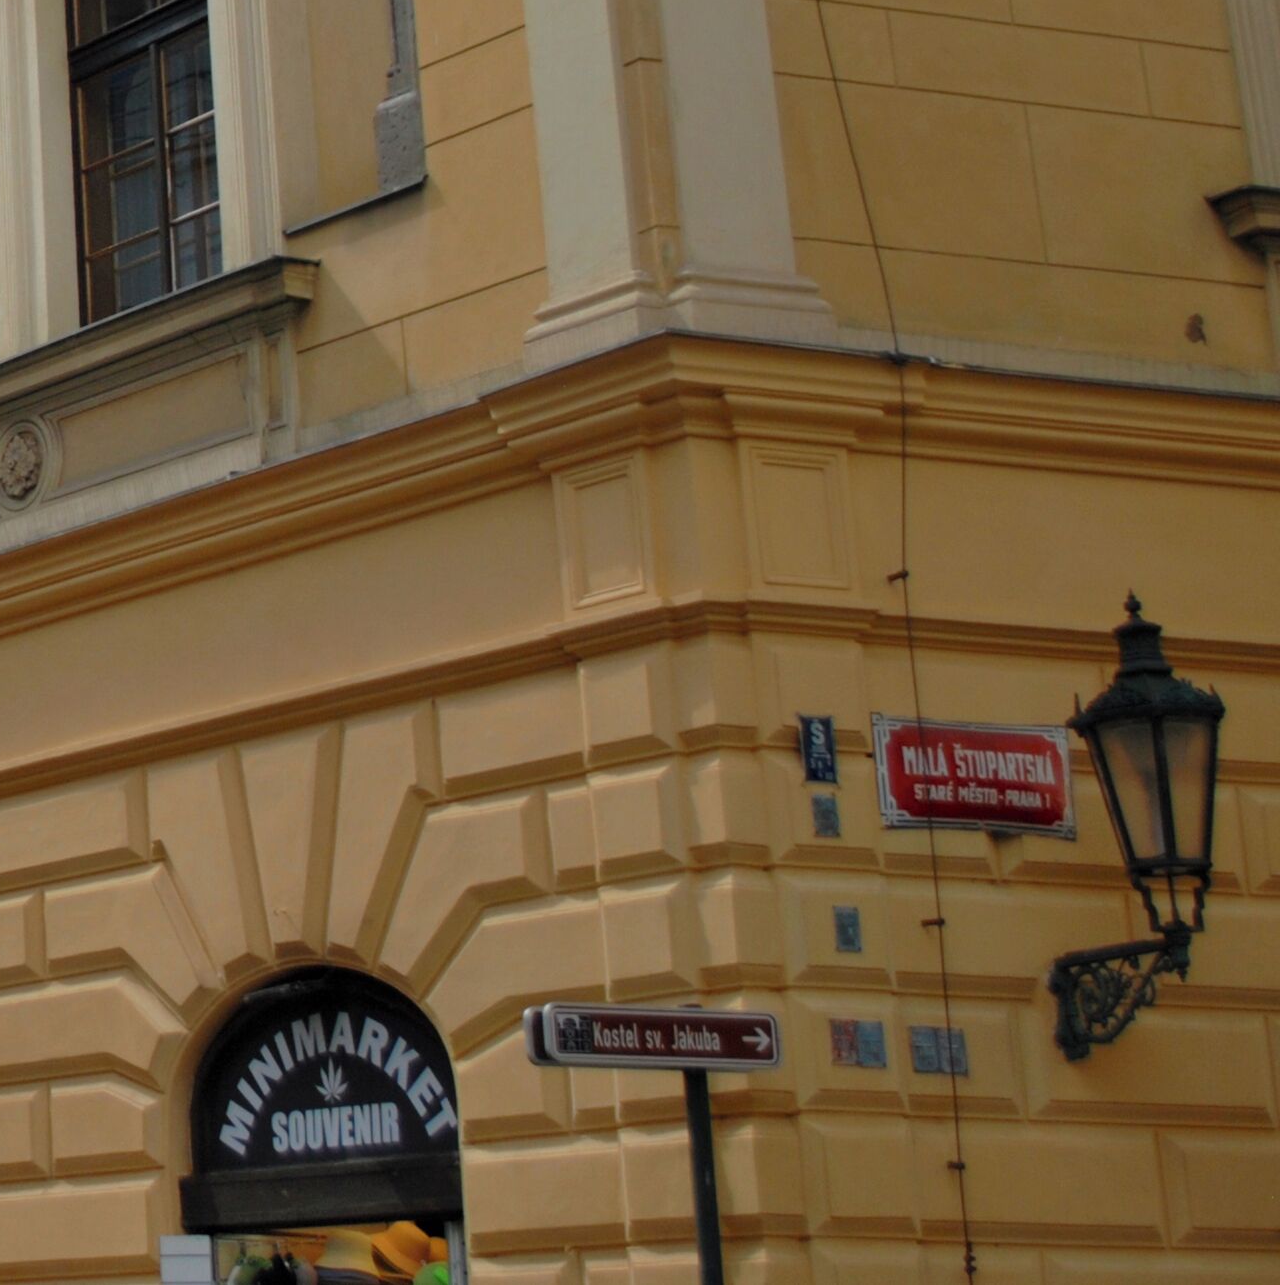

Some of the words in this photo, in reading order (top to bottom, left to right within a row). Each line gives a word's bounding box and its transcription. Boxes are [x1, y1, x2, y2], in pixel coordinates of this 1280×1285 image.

[902, 743, 948, 777] MALÁ
[953, 743, 1056, 785] ŠTUPARTSKÁ
[913, 781, 953, 802] STARÉ
[592, 1021, 639, 1050] Kostel
[645, 1029, 665, 1050] sv.
[672, 1024, 720, 1051] Jakuba
[219, 1011, 458, 1156] MINIMARKET
[271, 1102, 400, 1153] SOUVENIR
